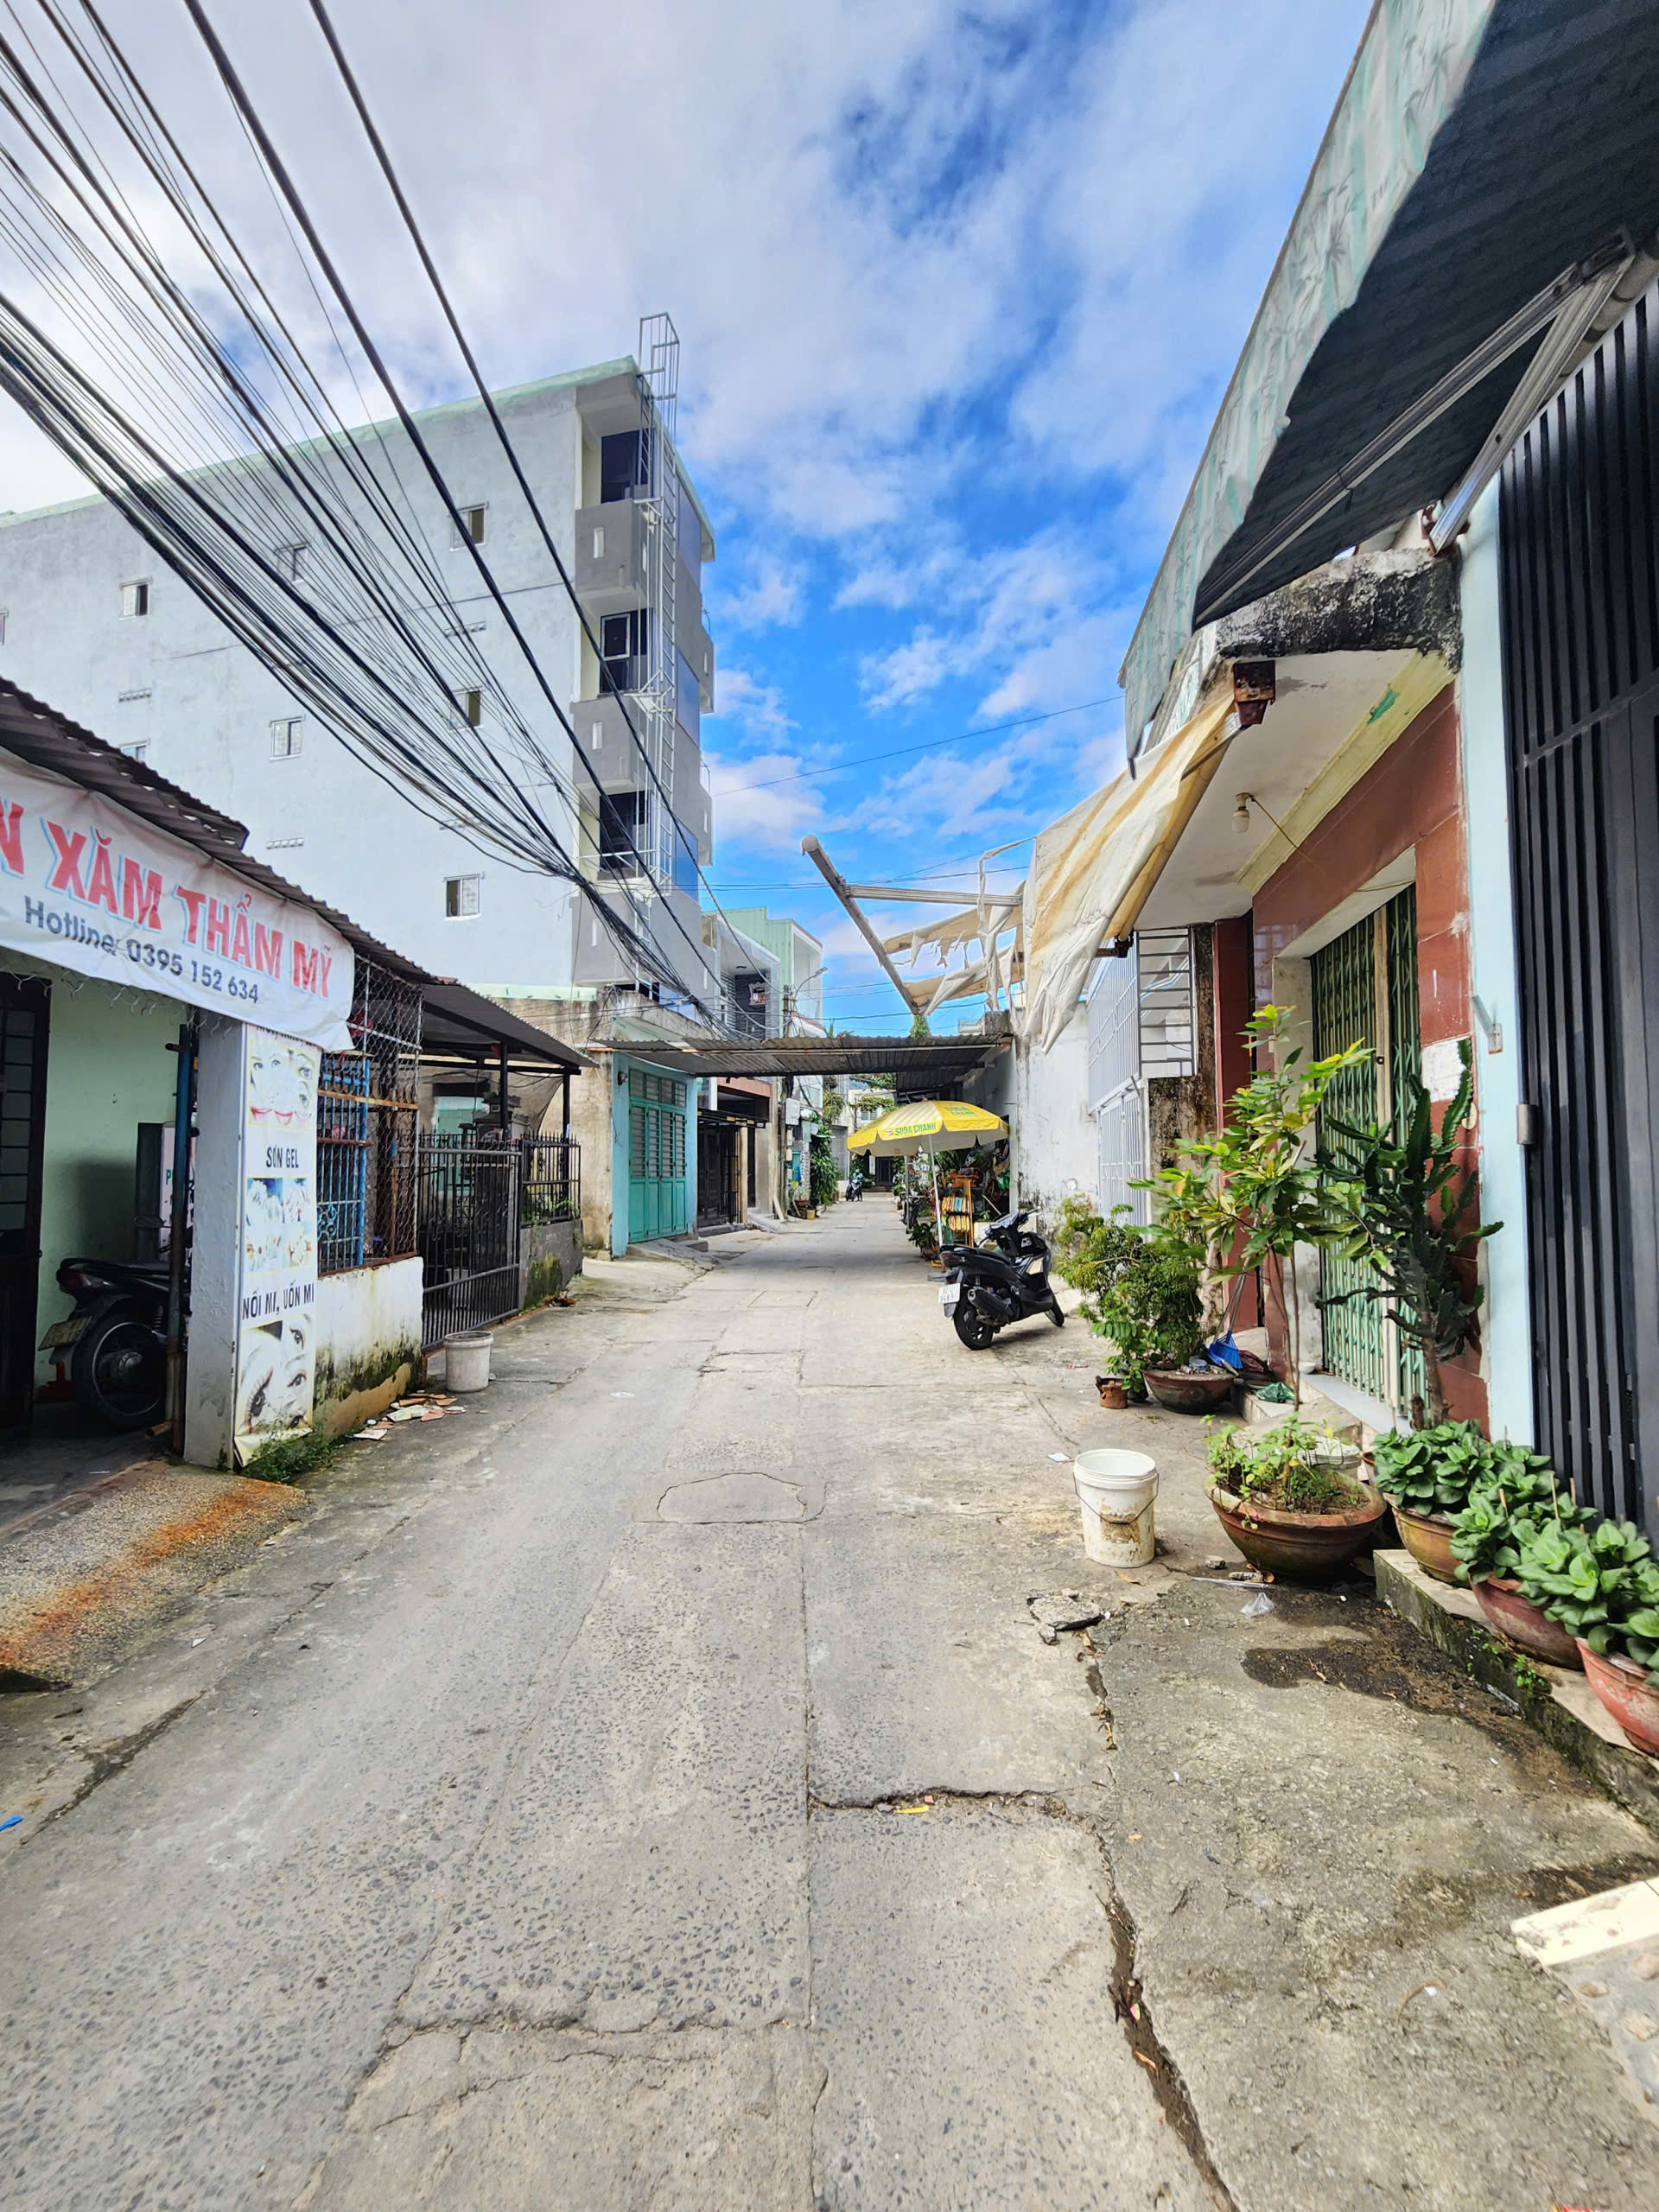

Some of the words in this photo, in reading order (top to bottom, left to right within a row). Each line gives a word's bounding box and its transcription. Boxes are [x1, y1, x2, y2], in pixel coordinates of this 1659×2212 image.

[45, 819, 163, 931] XĂM
[175, 886, 283, 980] THẨM
[125, 938, 183, 976] 0395
[191, 960, 222, 991] 152
[227, 977, 259, 1004] 634
[895, 1127, 912, 1136] SODA
[914, 1122, 937, 1134] CHANH
[286, 1147, 299, 1168] GEL
[303, 1282, 315, 1304] MI
